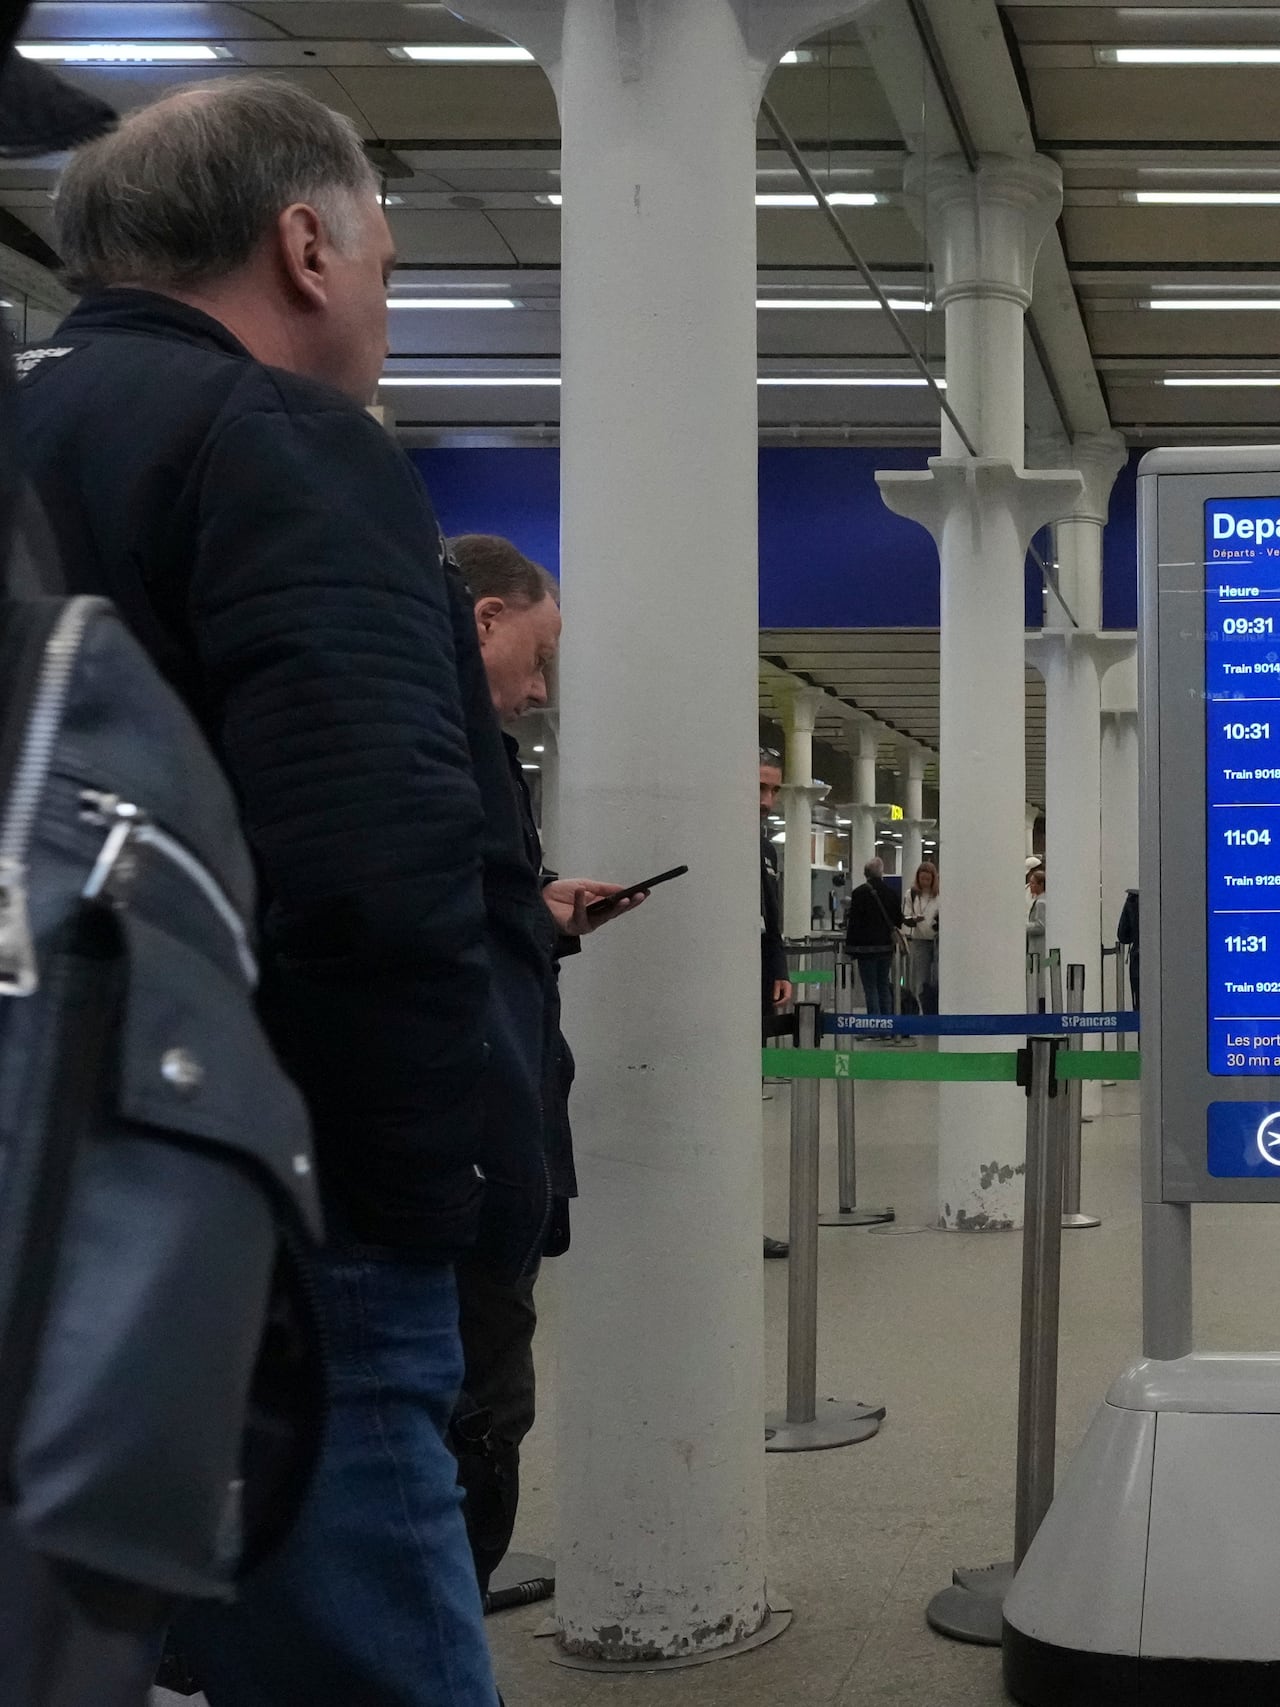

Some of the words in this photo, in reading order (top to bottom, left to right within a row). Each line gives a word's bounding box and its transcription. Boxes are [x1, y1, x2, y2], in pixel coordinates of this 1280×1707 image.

[1212, 548, 1256, 560] Départs
[1218, 584, 1260, 598] Heure
[1222, 617, 1273, 635] 09:31
[1222, 663, 1253, 674] Train
[1223, 722, 1270, 740] 10:31
[1223, 769, 1254, 780] Train
[1223, 829, 1272, 846] 11:04
[1223, 875, 1254, 886] Train
[1224, 935, 1267, 953] 11:31
[1224, 981, 1255, 993] Train
[1226, 1033, 1251, 1047] Les
[1226, 1053, 1246, 1067] 30
[1248, 1056, 1271, 1067] mn
